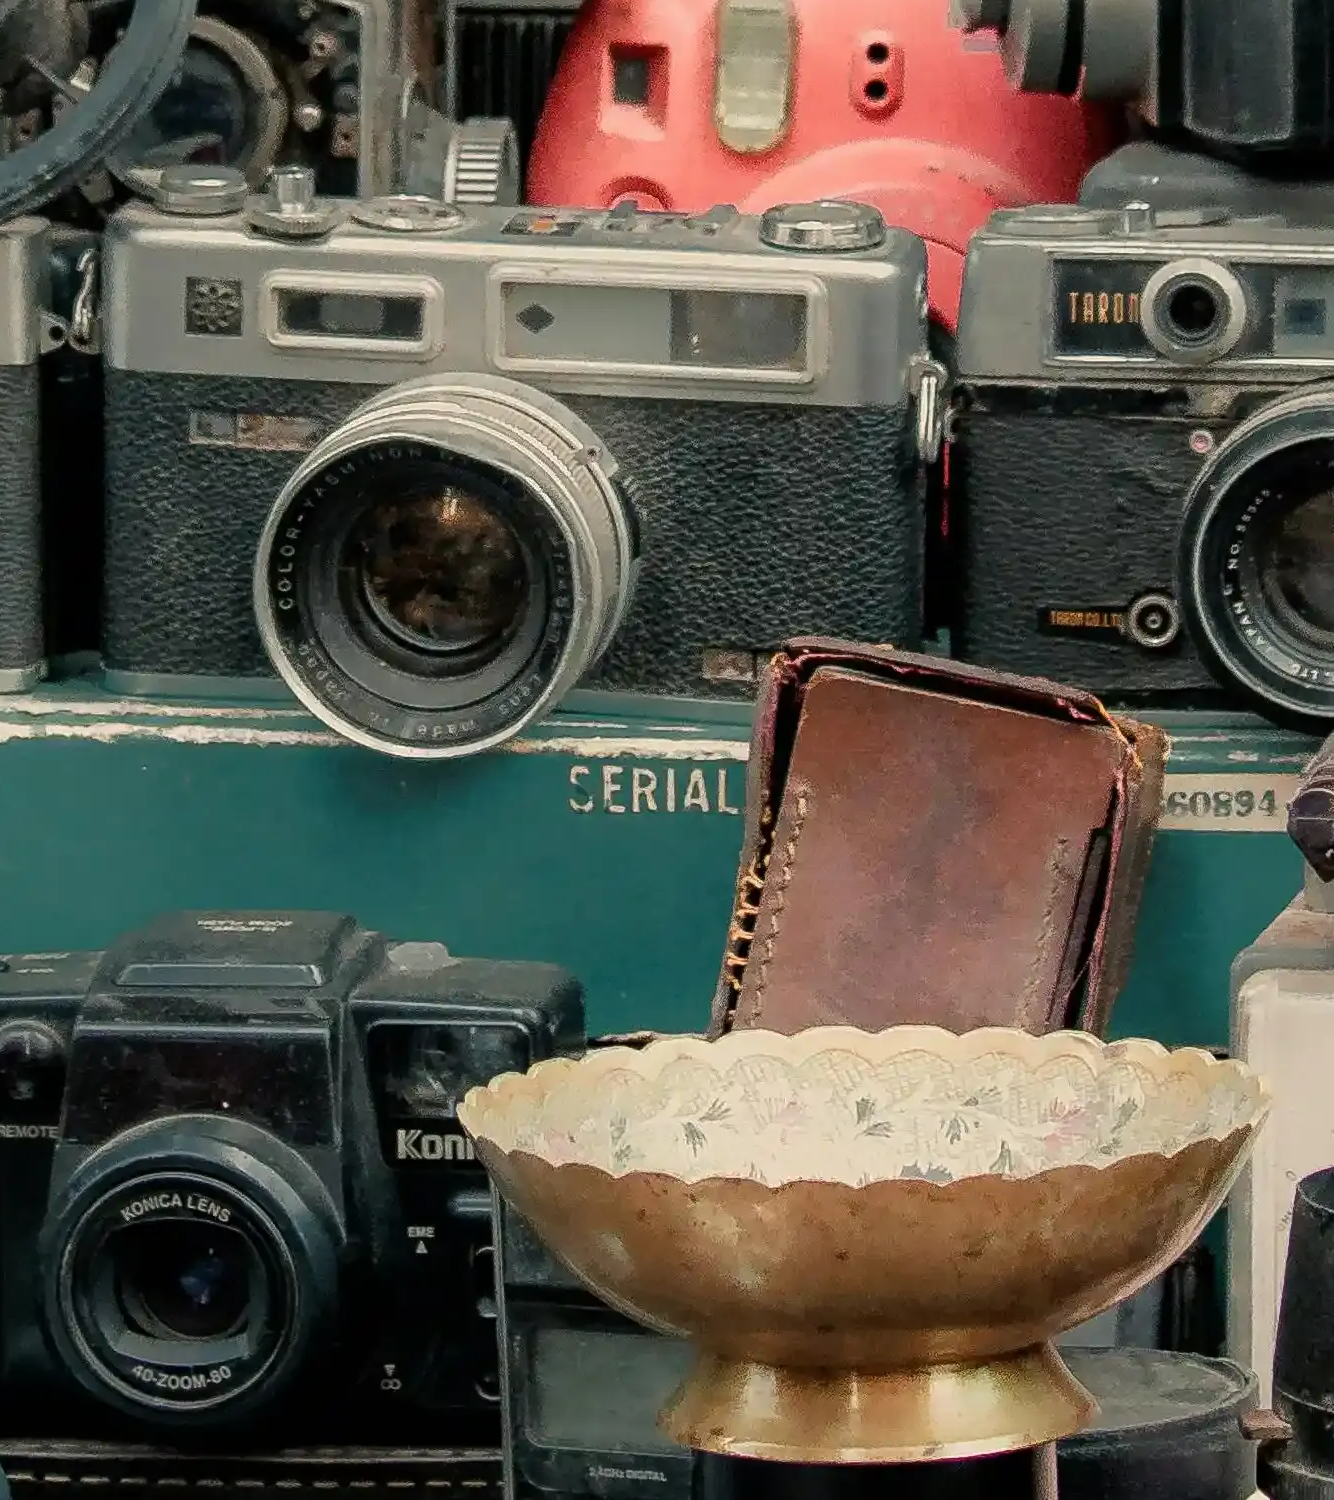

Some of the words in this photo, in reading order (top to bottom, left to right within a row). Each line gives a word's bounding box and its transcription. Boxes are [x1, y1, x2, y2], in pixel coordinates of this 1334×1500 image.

[1068, 291, 1141, 325] TARON
[568, 765, 740, 815] SERIAL
[396, 1129, 475, 1161] Koni
[119, 1192, 183, 1222] KONICA
[186, 1194, 232, 1223] LENS
[131, 1363, 232, 1391] 40-ZOOM-80
